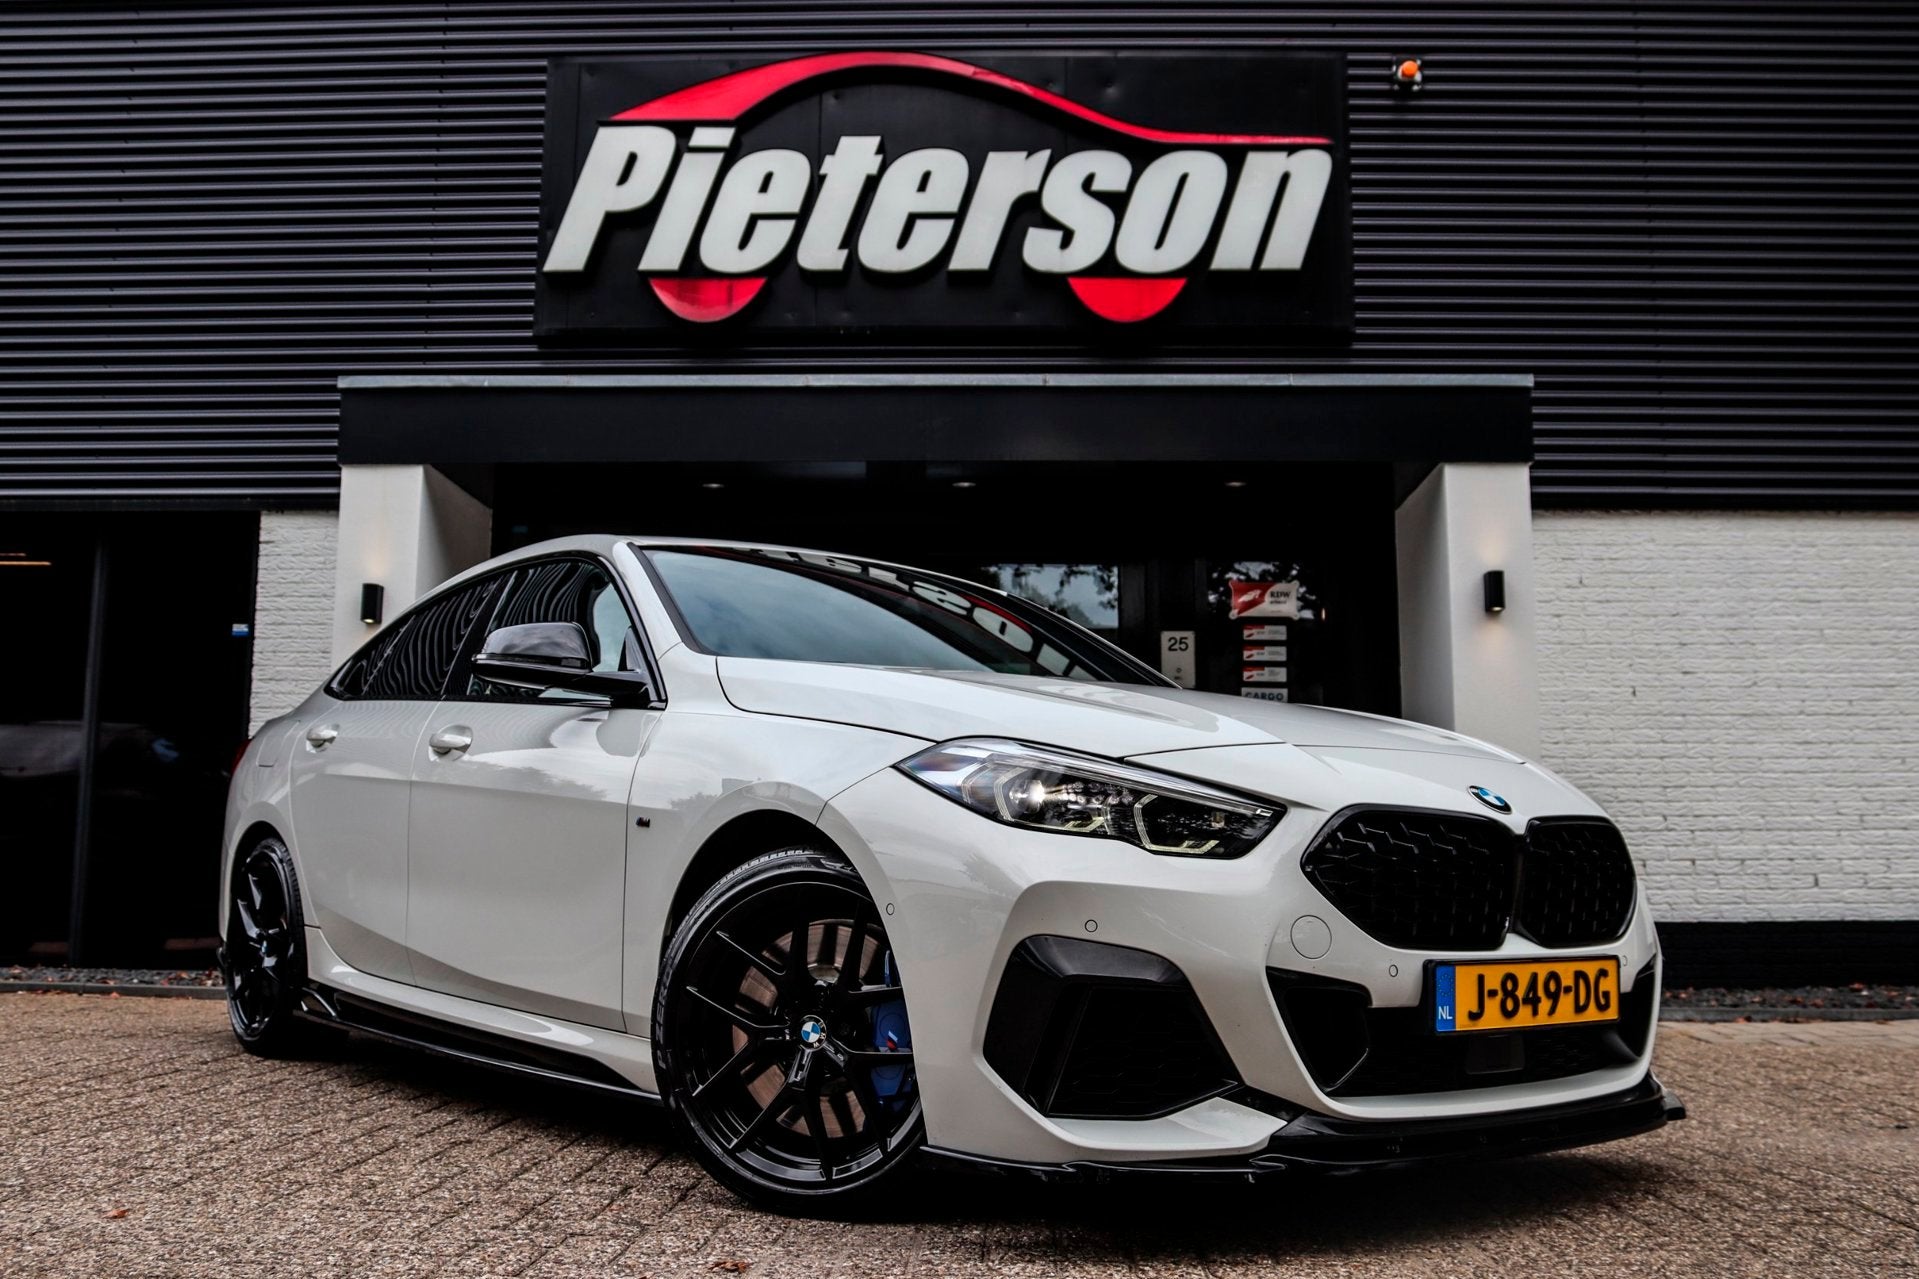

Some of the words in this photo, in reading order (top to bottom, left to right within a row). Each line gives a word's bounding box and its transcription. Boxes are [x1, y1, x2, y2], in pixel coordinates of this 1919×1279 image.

[541, 124, 1335, 275] Pieterson
[1168, 636, 1189, 652] 25
[1438, 1004, 1453, 1020] NL
[1468, 968, 1611, 1022] J-849-DG
